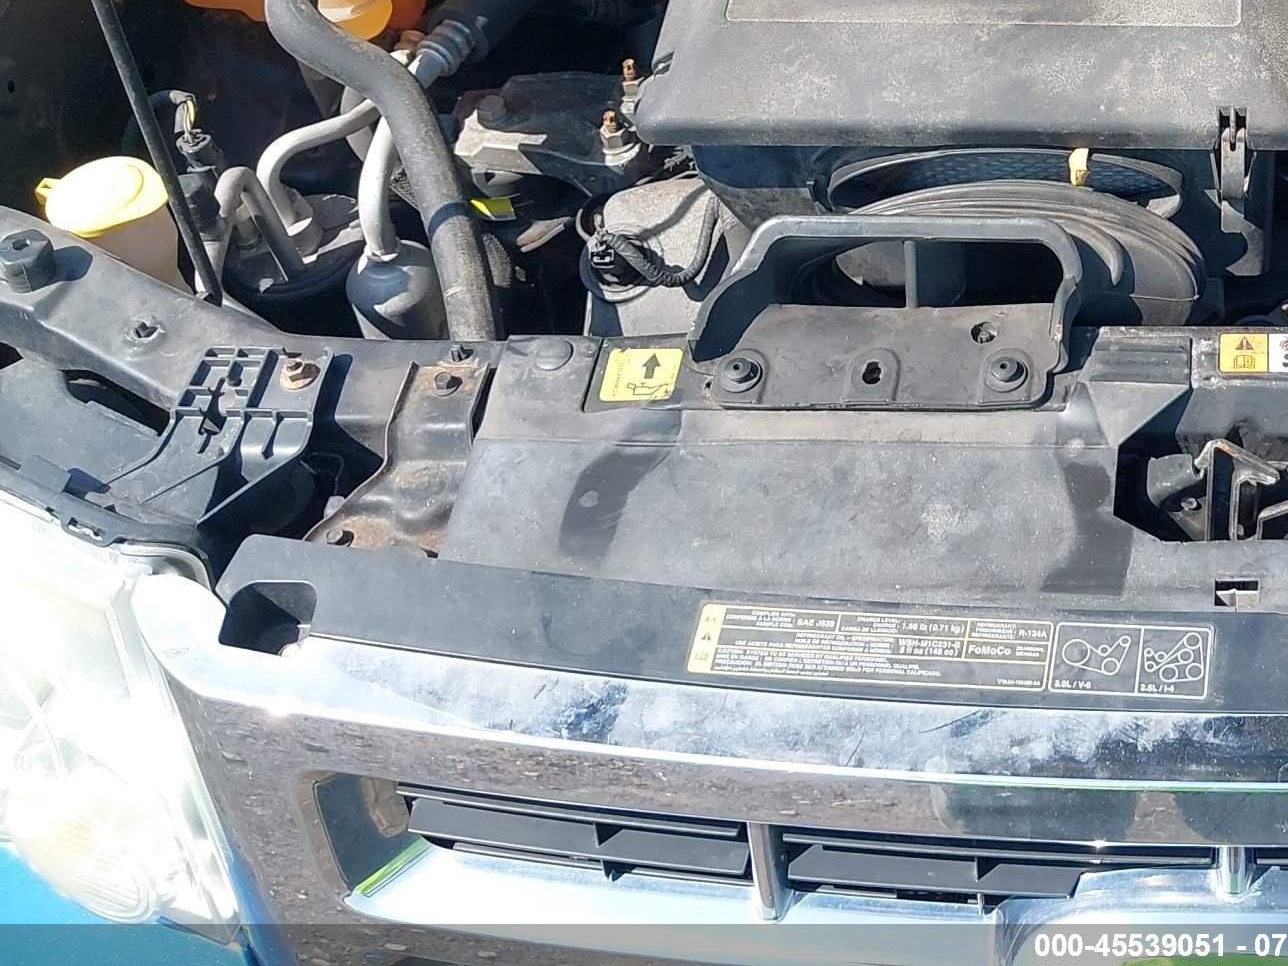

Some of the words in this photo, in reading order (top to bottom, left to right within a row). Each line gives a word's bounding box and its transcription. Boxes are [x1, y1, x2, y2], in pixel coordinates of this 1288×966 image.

[796, 618, 814, 626] SAE
[1018, 629, 1047, 638] R-134A
[967, 644, 1011, 656] FoMoCo
